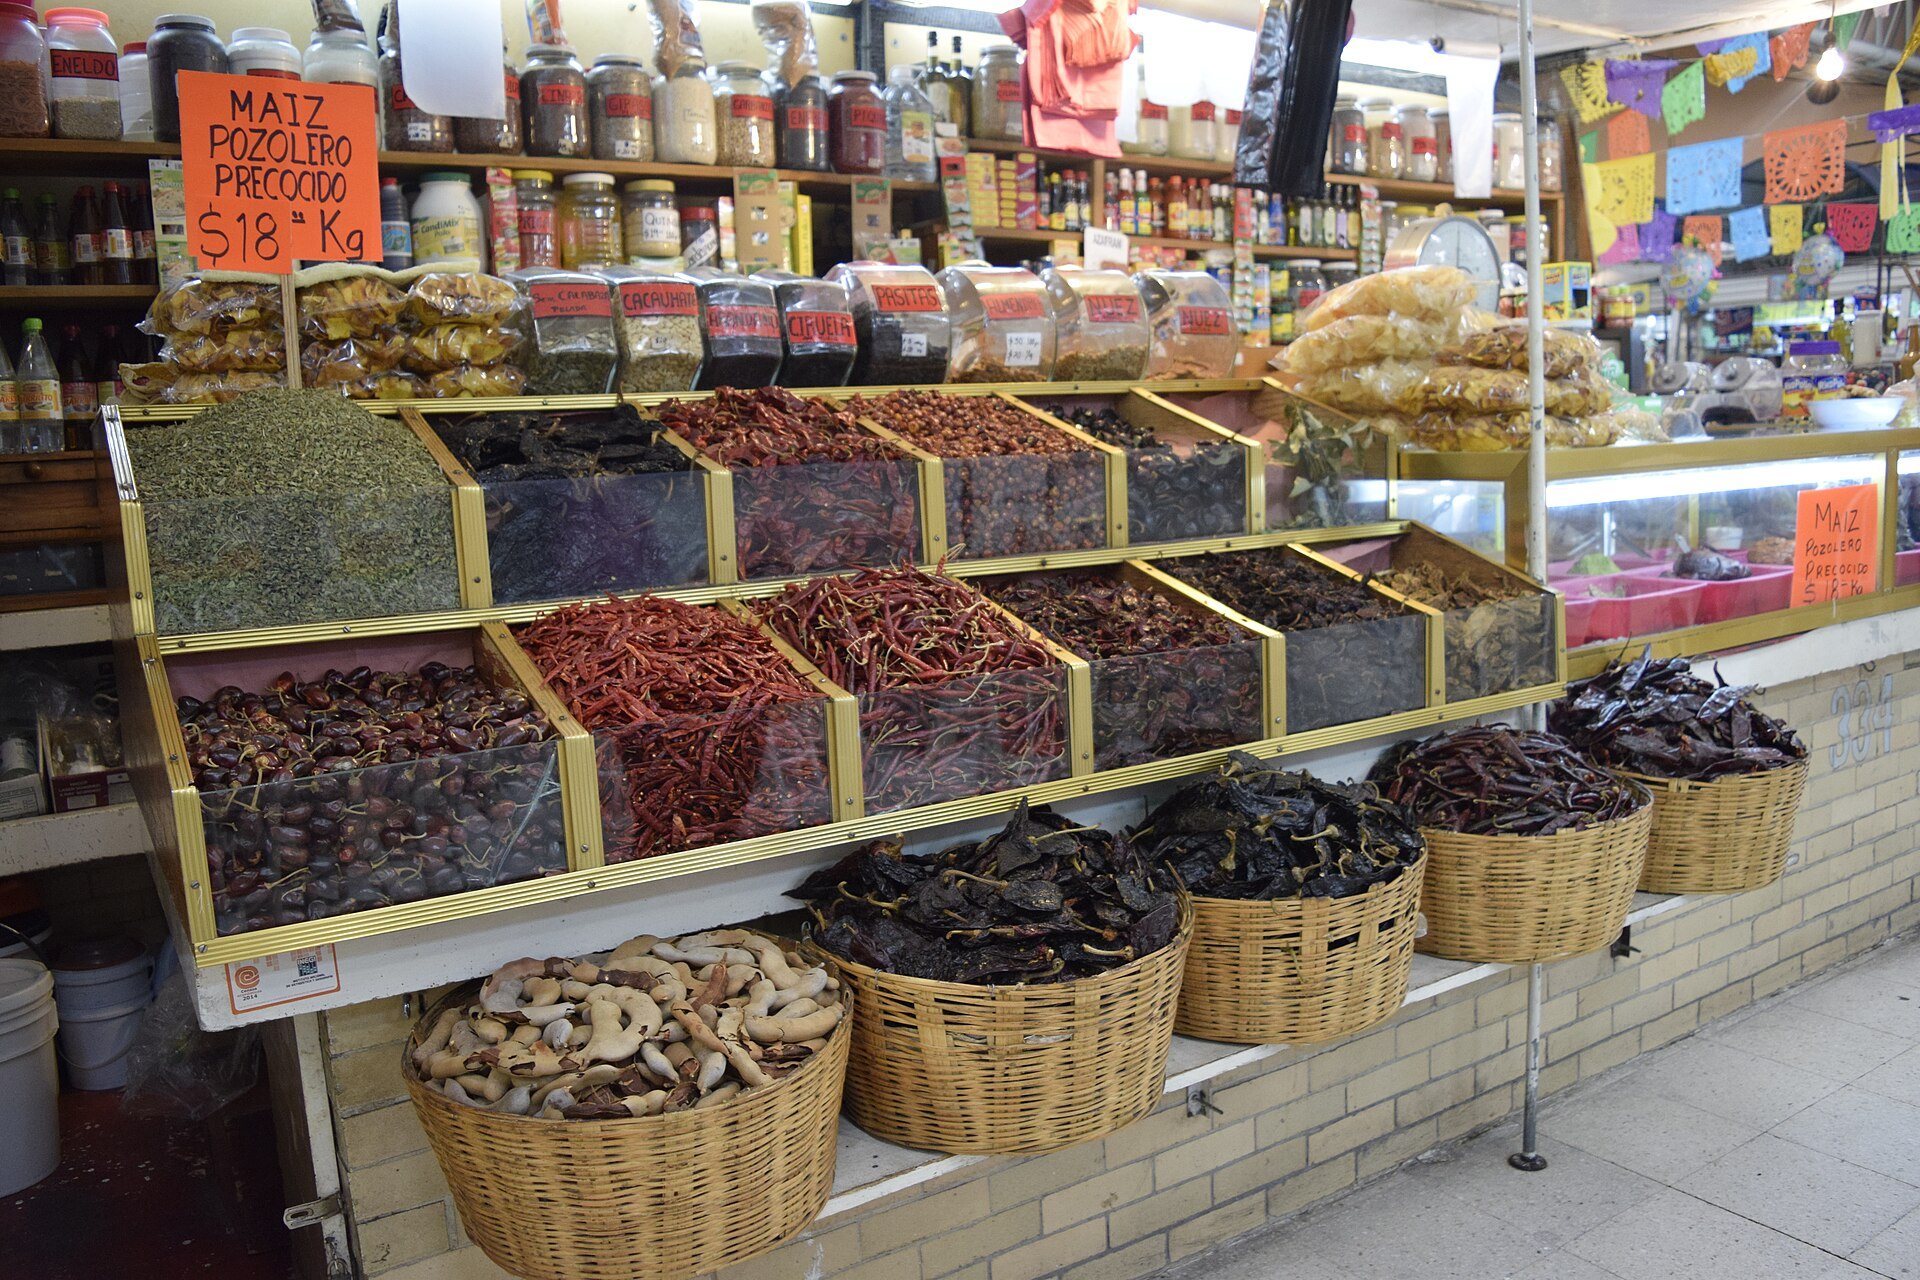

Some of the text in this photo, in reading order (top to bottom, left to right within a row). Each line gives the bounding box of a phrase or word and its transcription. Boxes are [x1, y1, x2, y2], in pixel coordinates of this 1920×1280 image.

[51, 55, 117, 76] ENELDO
[230, 90, 329, 130] MAIZ
[209, 124, 352, 167] POZOLERO
[215, 164, 347, 202] PRECOCIDO
[320, 208, 363, 260] Kg
[876, 286, 938, 307] PASITAS
[1087, 297, 1137, 316] NUEZ
[788, 315, 851, 337] CIRUELA
[1183, 310, 1221, 328] NUEZ
[1815, 501, 1860, 533] MAIZ
[1806, 537, 1862, 557] POZOLERO
[1805, 560, 1869, 580] PRECOCIDO
[1828, 673, 1893, 770] 334
